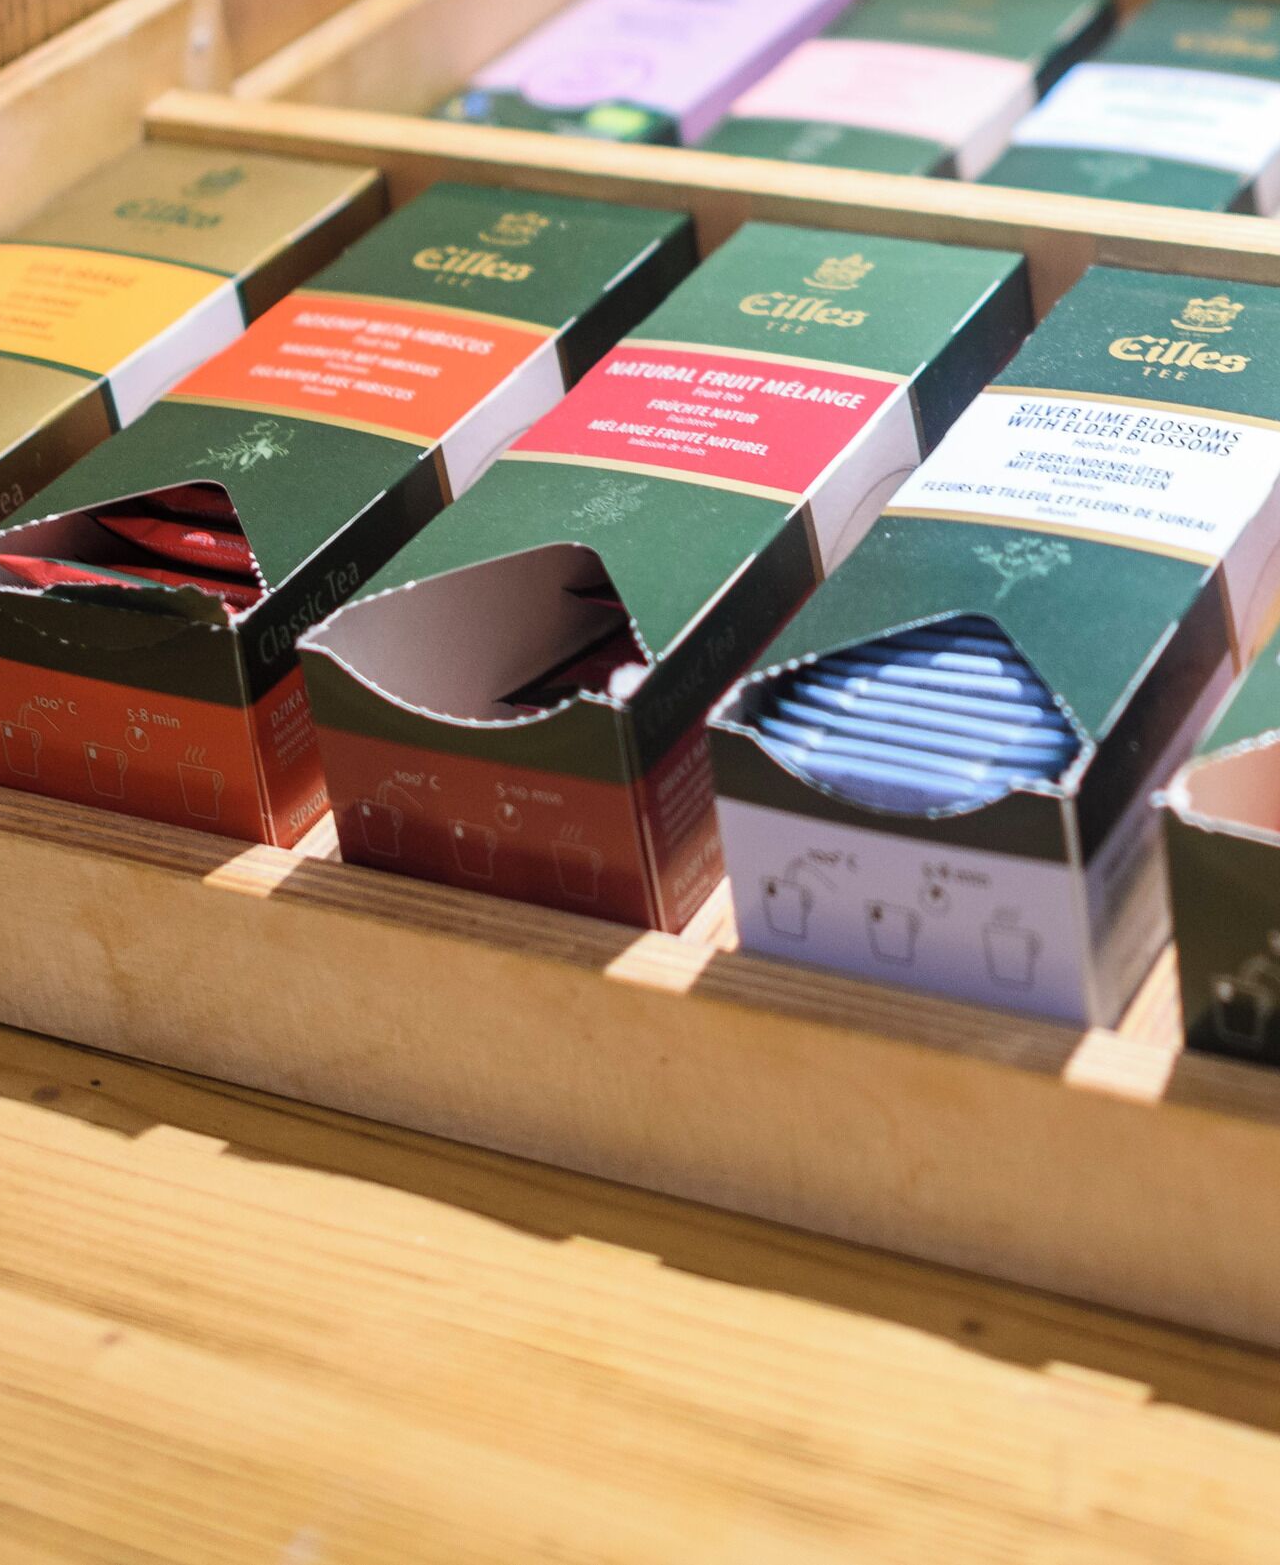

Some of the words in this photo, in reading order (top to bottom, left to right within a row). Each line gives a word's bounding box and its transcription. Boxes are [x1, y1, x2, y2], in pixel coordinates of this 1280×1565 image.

[739, 291, 869, 327] Eilles
[414, 325, 495, 357] HIBISCUS
[766, 321, 809, 335] TEE
[1108, 334, 1251, 374] Eilles
[605, 361, 698, 384] NATURAL
[698, 369, 764, 393] FRUIT
[760, 380, 865, 410] MÉLANGE
[1142, 366, 1189, 381] TEE
[692, 386, 722, 400] Fruit
[723, 390, 744, 403] tea
[646, 398, 712, 418] FRÜCHTE
[709, 407, 760, 425] NATUR
[1015, 402, 1082, 420] SILVER
[1084, 409, 1132, 424] LIME
[1137, 415, 1242, 443] BLOSSOMS
[588, 419, 656, 437] MÉLANGE
[654, 426, 708, 446] FRUITÉ
[704, 437, 769, 457] NATUREL
[1007, 414, 1058, 431] WITH
[1061, 420, 1121, 439] ELDER
[1126, 427, 1234, 457] BLOSSOMS
[1071, 437, 1117, 452] Herbal
[1119, 444, 1141, 456] tea
[1005, 460, 1036, 472] MIT
[1037, 462, 1169, 491] HOLUNDERBLÜTEN
[1018, 449, 1174, 480] SILBERLINDENBLÜTEN
[921, 480, 974, 493] FLEURS
[976, 484, 997, 495] DE
[997, 487, 1053, 503] TILLEUL
[1055, 494, 1074, 506] ET
[1075, 496, 1130, 515] FLEURS
[1134, 506, 1154, 519] DE
[1155, 510, 1216, 533] SUREAU
[259, 596, 325, 665] Classic
[324, 560, 361, 600] Tea
[33, 694, 65, 711] 100°
[67, 701, 78, 716] C
[127, 707, 149, 723] 5-8
[151, 712, 181, 729] min
[531, 790, 564, 806] min
